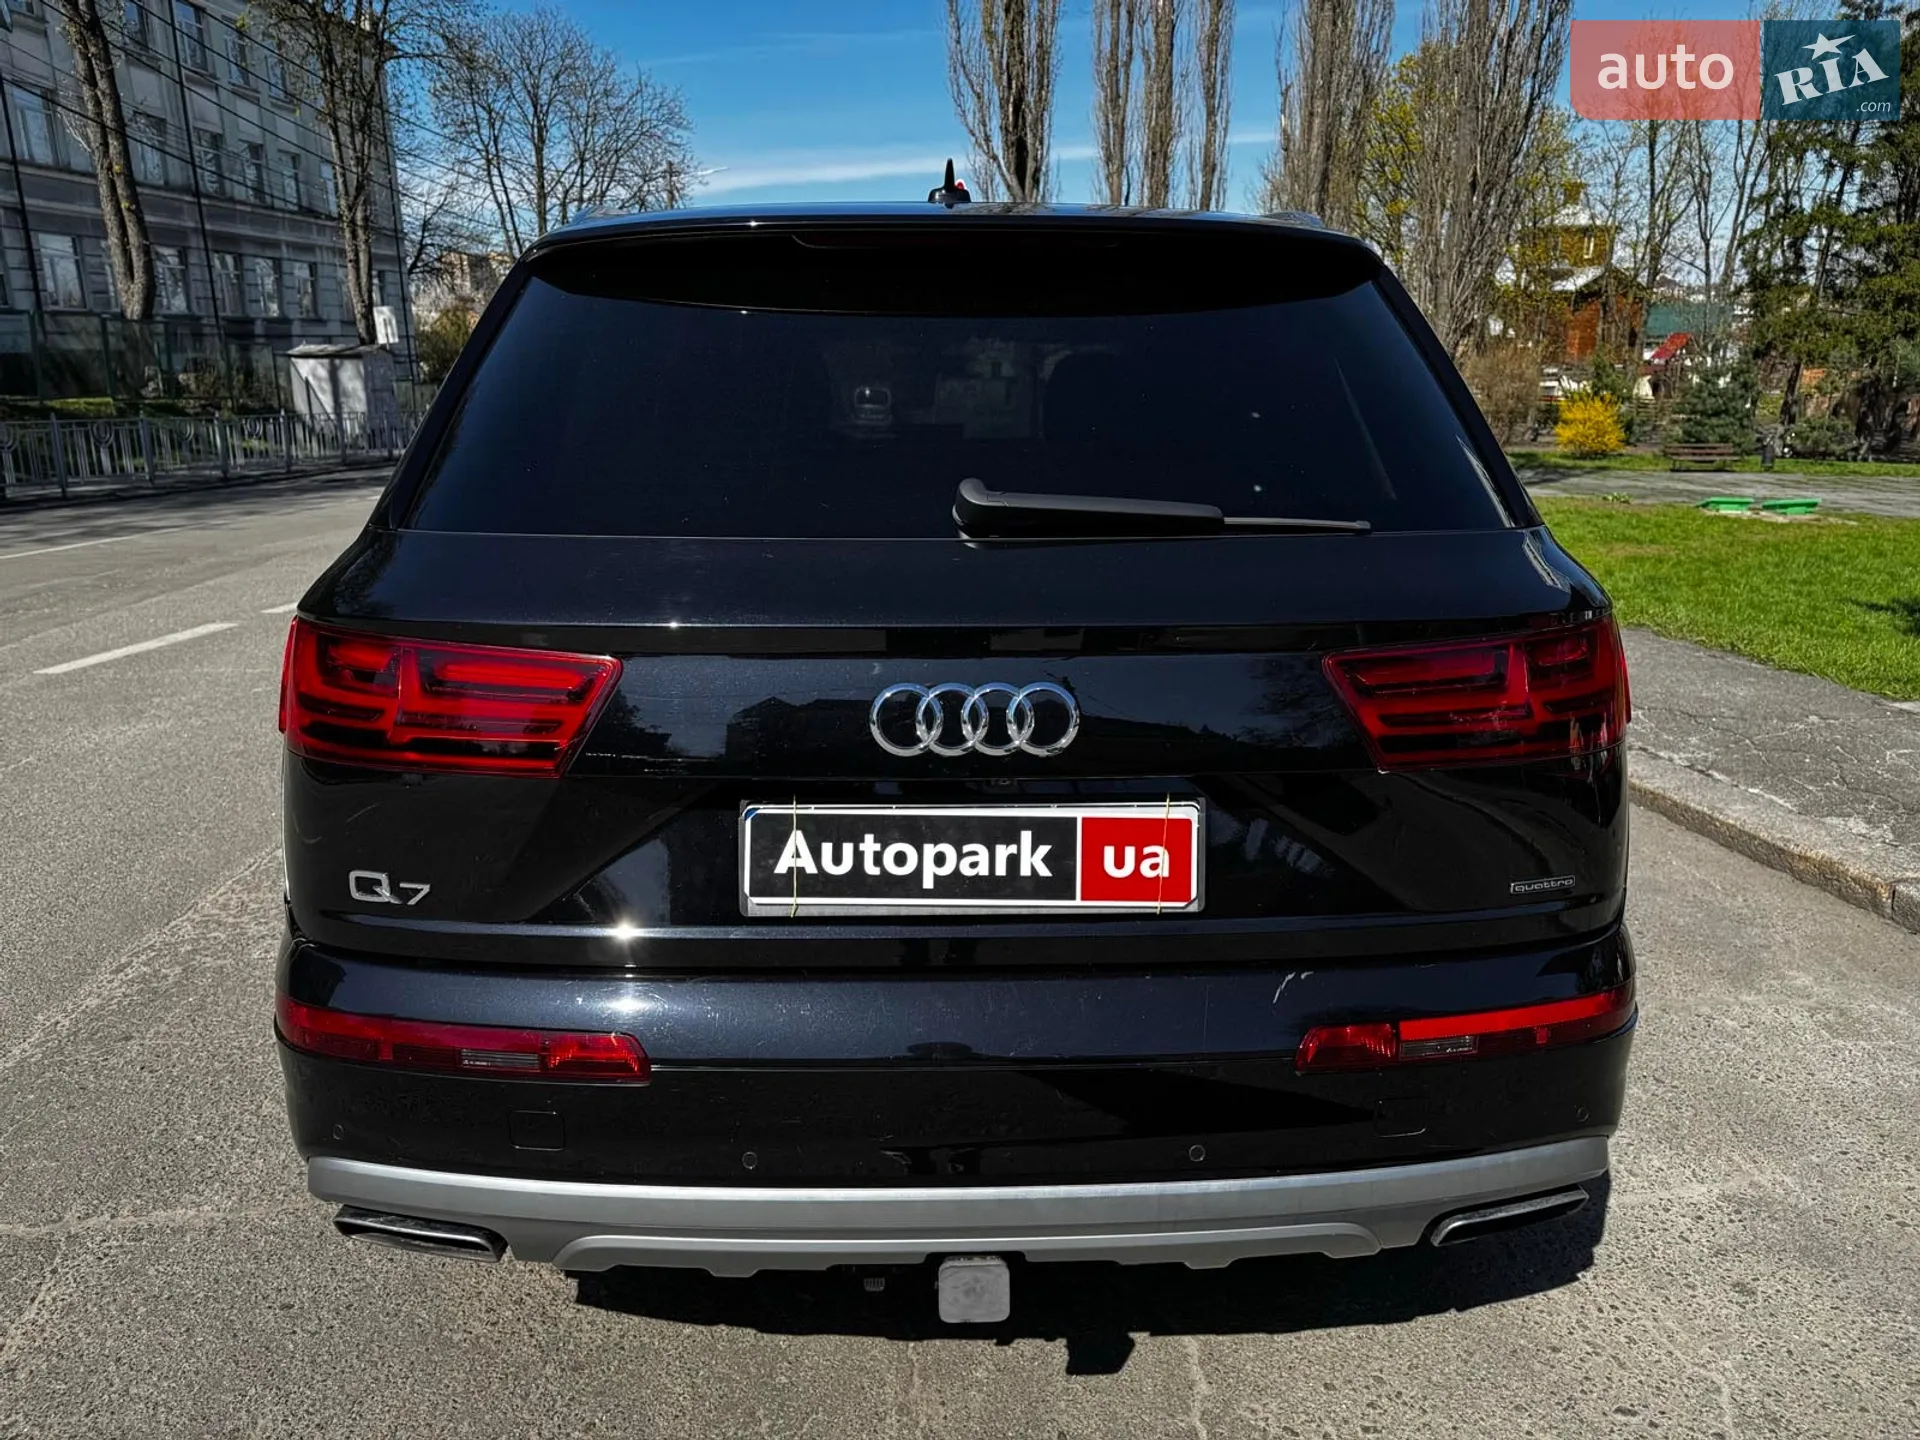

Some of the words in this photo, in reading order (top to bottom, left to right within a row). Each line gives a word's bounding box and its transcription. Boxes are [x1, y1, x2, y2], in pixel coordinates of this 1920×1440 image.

[773, 829, 1053, 889] Autopark
[1103, 845, 1170, 878] ua
[349, 869, 431, 905] Q7
[1515, 879, 1573, 892] quattro
